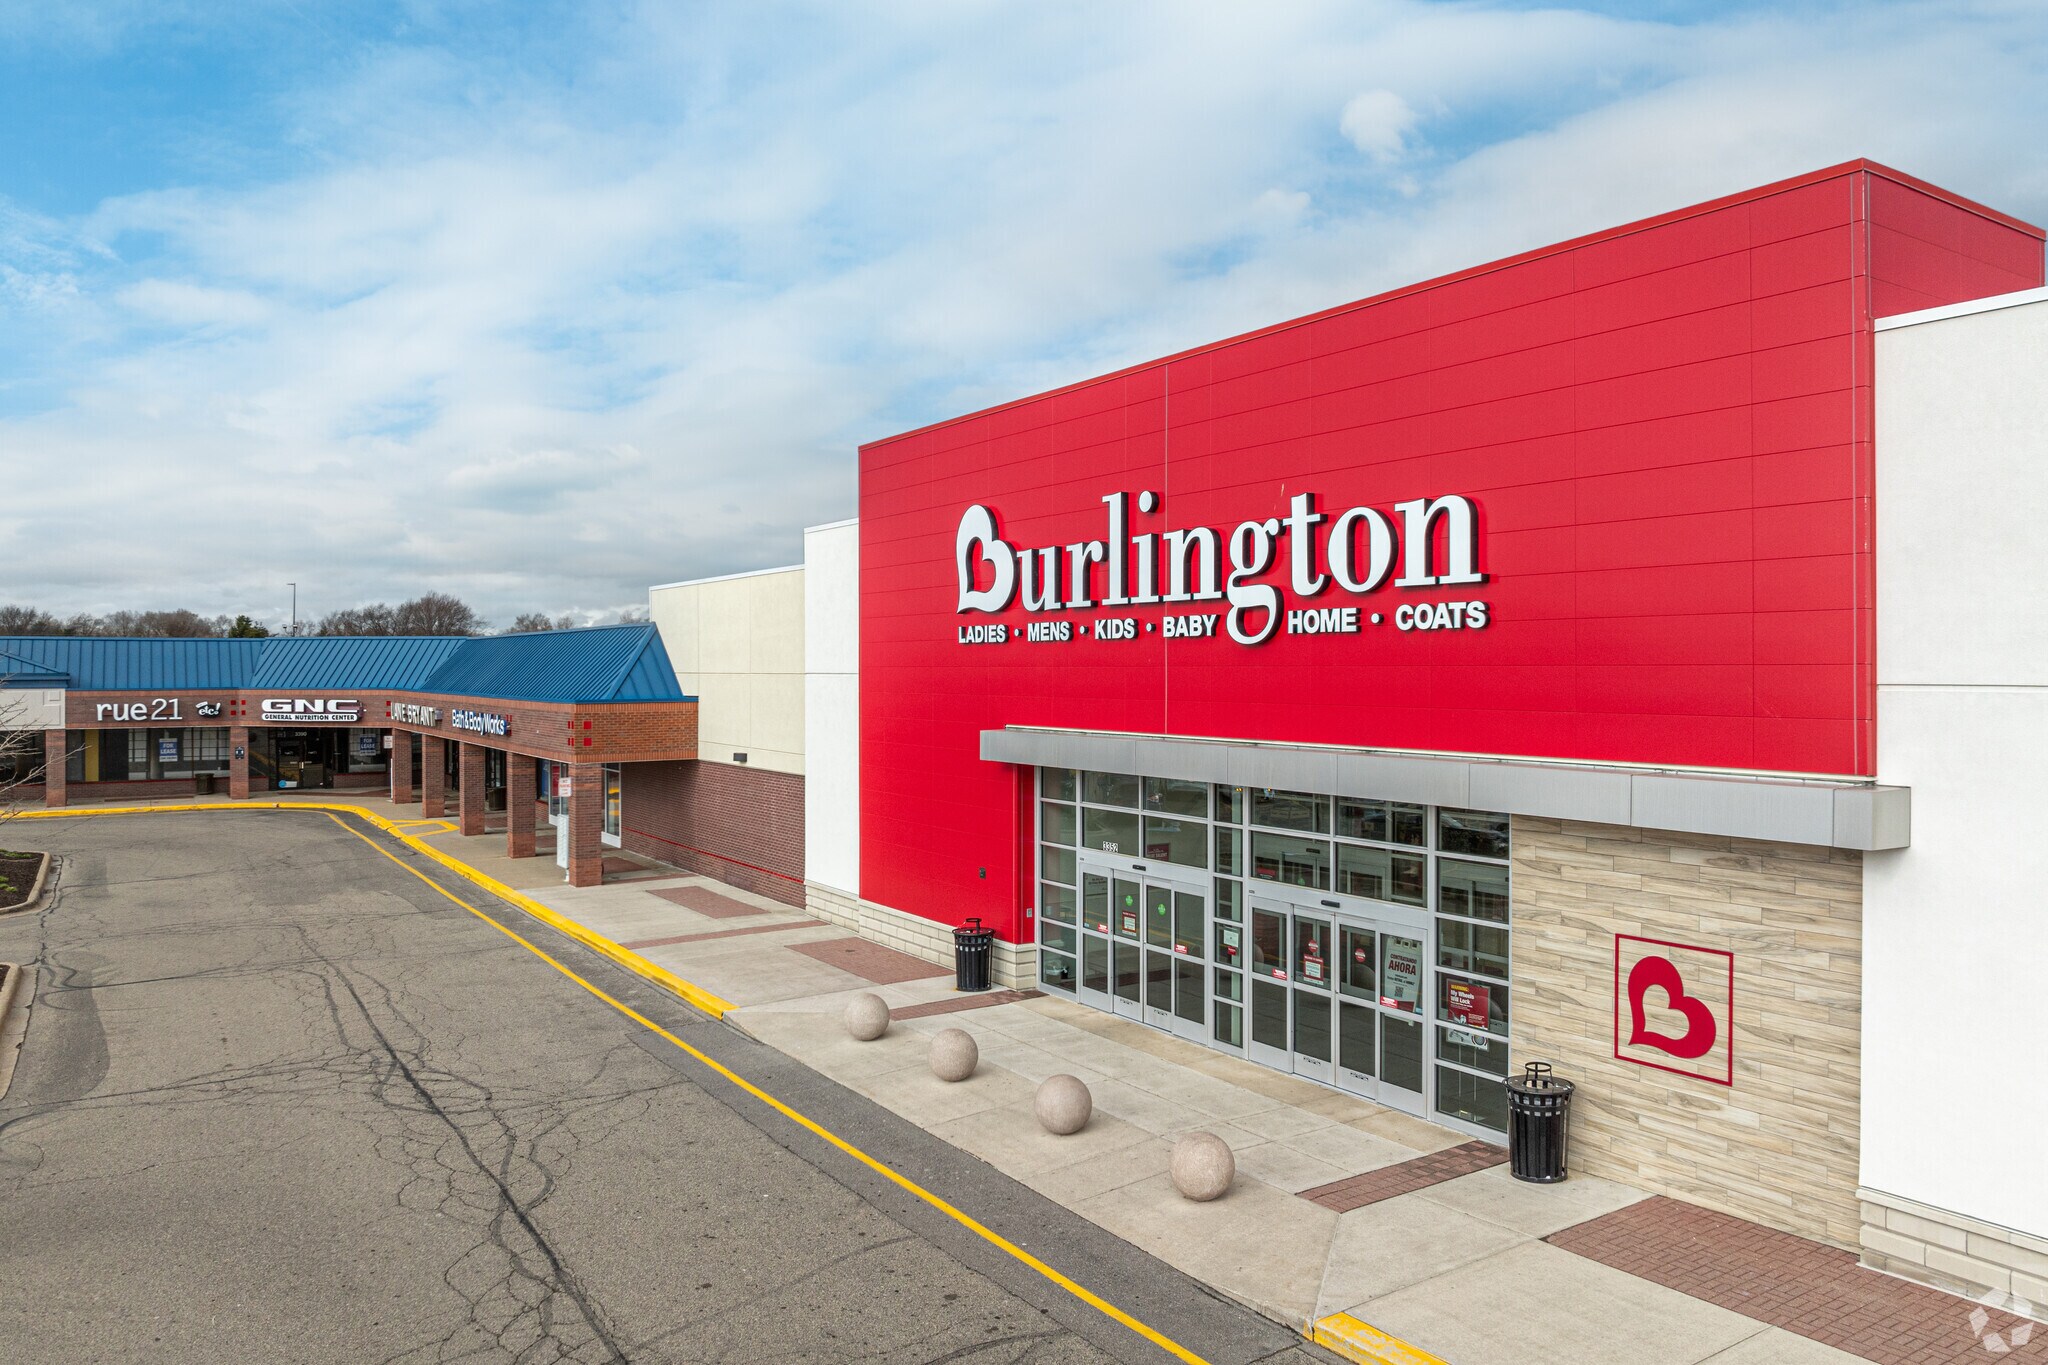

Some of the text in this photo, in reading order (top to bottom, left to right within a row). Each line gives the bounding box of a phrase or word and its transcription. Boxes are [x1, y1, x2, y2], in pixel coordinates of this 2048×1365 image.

[956, 491, 1486, 645] Burlington
[957, 600, 1487, 645] LADIES MENS KIDS BABY HOME COATS
[261, 699, 358, 713] GNC
[391, 702, 436, 727] LANE BRYANT
[1388, 960, 1417, 976] AHORA
